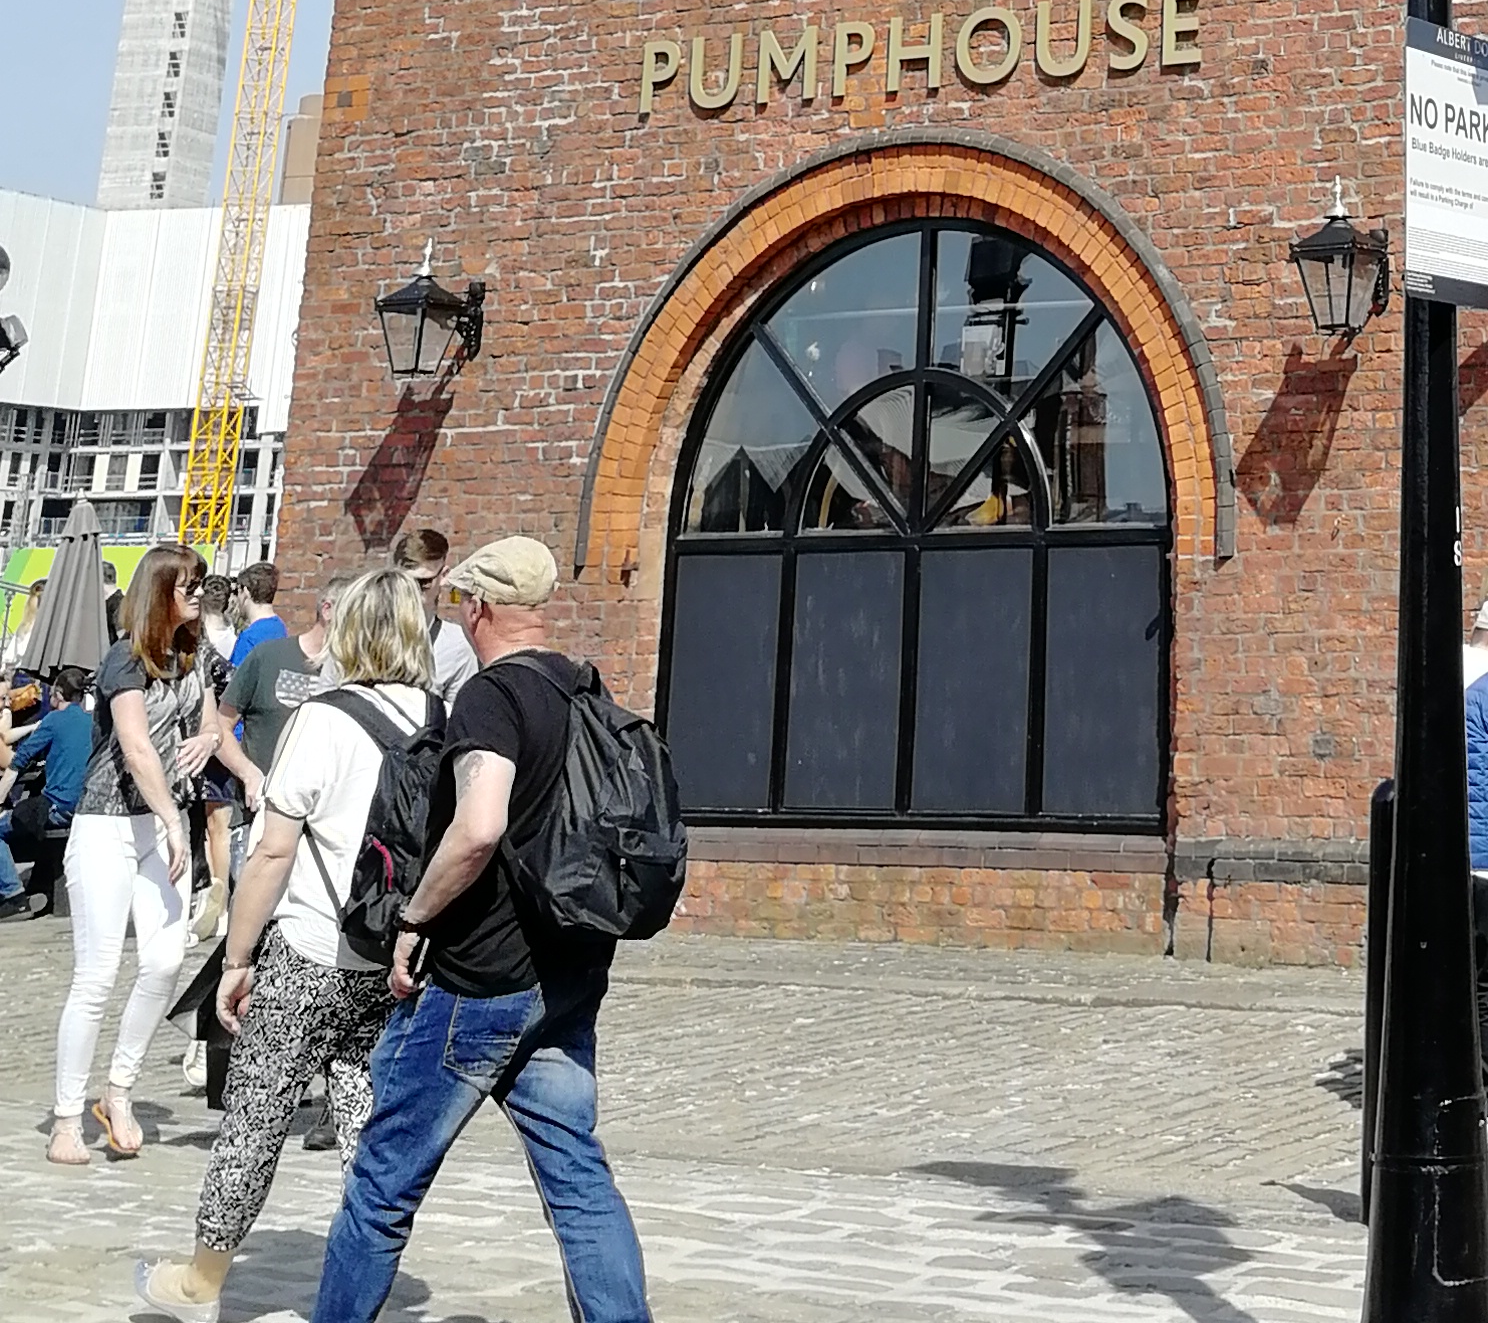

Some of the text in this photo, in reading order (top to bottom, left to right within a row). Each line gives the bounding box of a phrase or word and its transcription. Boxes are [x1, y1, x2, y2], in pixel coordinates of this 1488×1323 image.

[1437, 27, 1471, 51] ALBERT
[1410, 93, 1438, 130] NO
[1412, 138, 1427, 152] Blue
[1429, 142, 1450, 160] Badge
[1452, 148, 1477, 164] Holders
[1479, 157, 1488, 167] are
